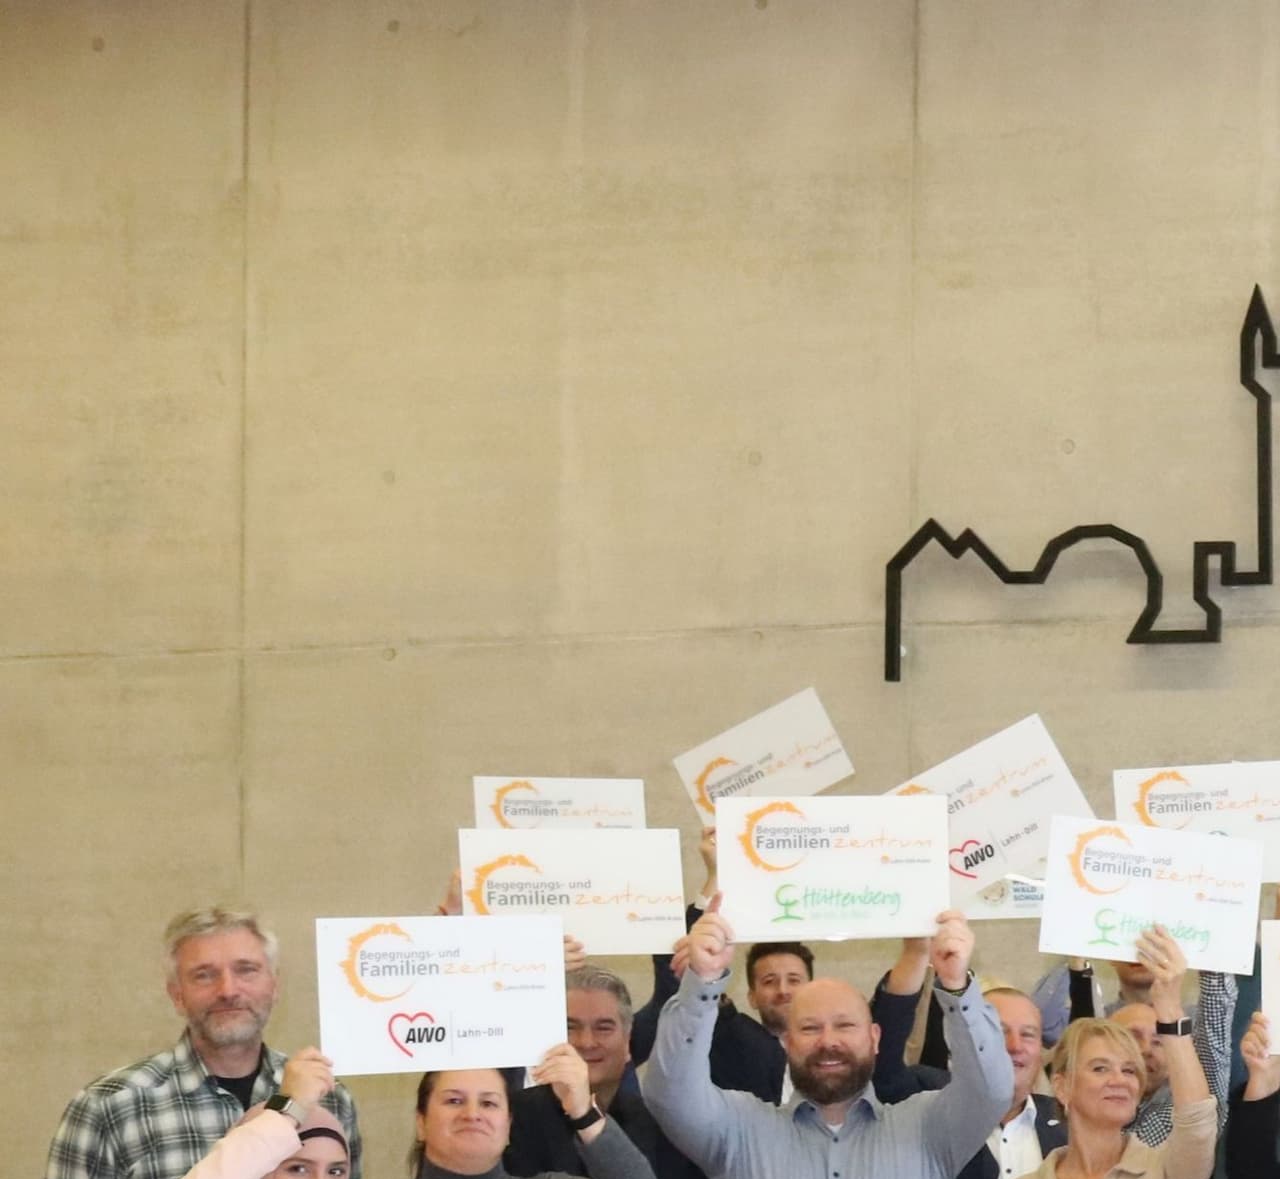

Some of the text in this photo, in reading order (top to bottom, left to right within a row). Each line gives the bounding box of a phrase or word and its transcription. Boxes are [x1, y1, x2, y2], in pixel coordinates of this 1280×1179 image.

[503, 806, 559, 817] Familien
[1149, 800, 1212, 814] Familien
[756, 824, 850, 837] Begegnungs- und
[755, 836, 830, 849] Familien
[963, 843, 995, 871] AWO
[1152, 855, 1172, 866] und
[1083, 857, 1152, 879] Familien
[486, 879, 592, 891] Begegnungs- und
[486, 891, 570, 906] Familien
[801, 884, 904, 916] Hüttenberg
[359, 948, 460, 962] Begegnungs- und
[359, 960, 440, 978] Familien
[405, 1026, 446, 1044] AWO
[457, 1027, 504, 1039] Lahn-Dill
